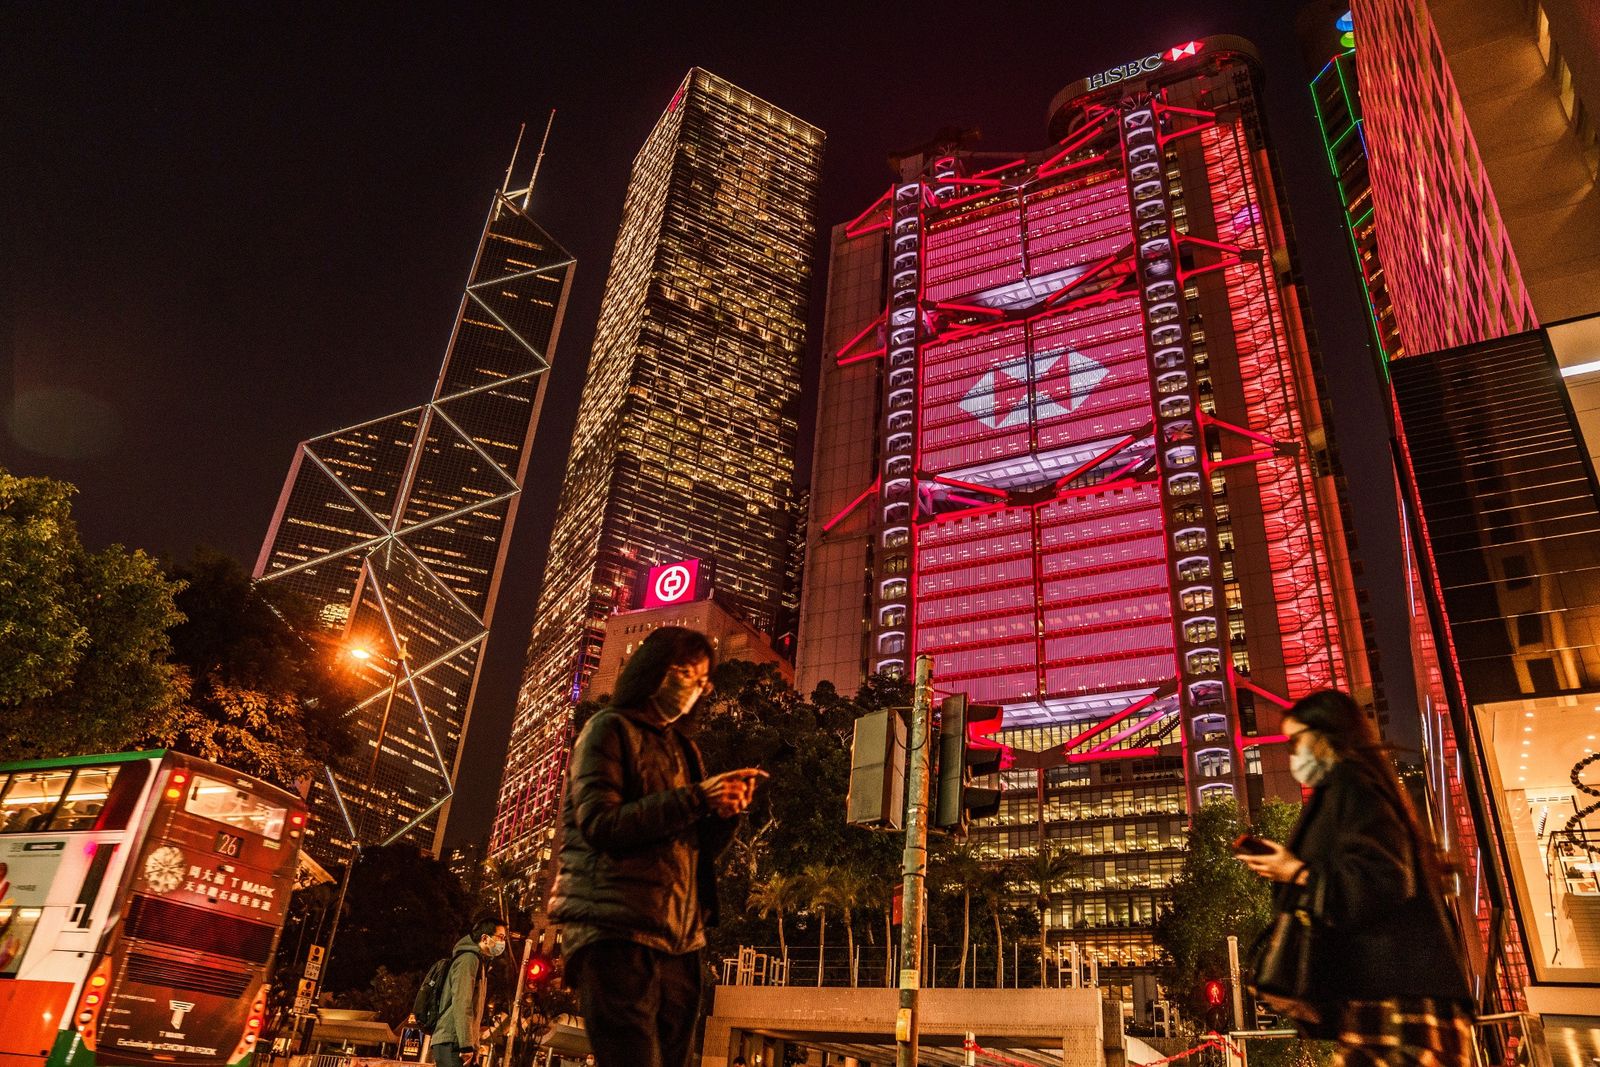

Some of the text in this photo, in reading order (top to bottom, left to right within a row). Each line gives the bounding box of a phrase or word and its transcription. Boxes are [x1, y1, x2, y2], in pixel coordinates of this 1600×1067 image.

[1086, 52, 1162, 91] HSBC
[219, 833, 238, 856] 26
[241, 880, 276, 899] MARK
